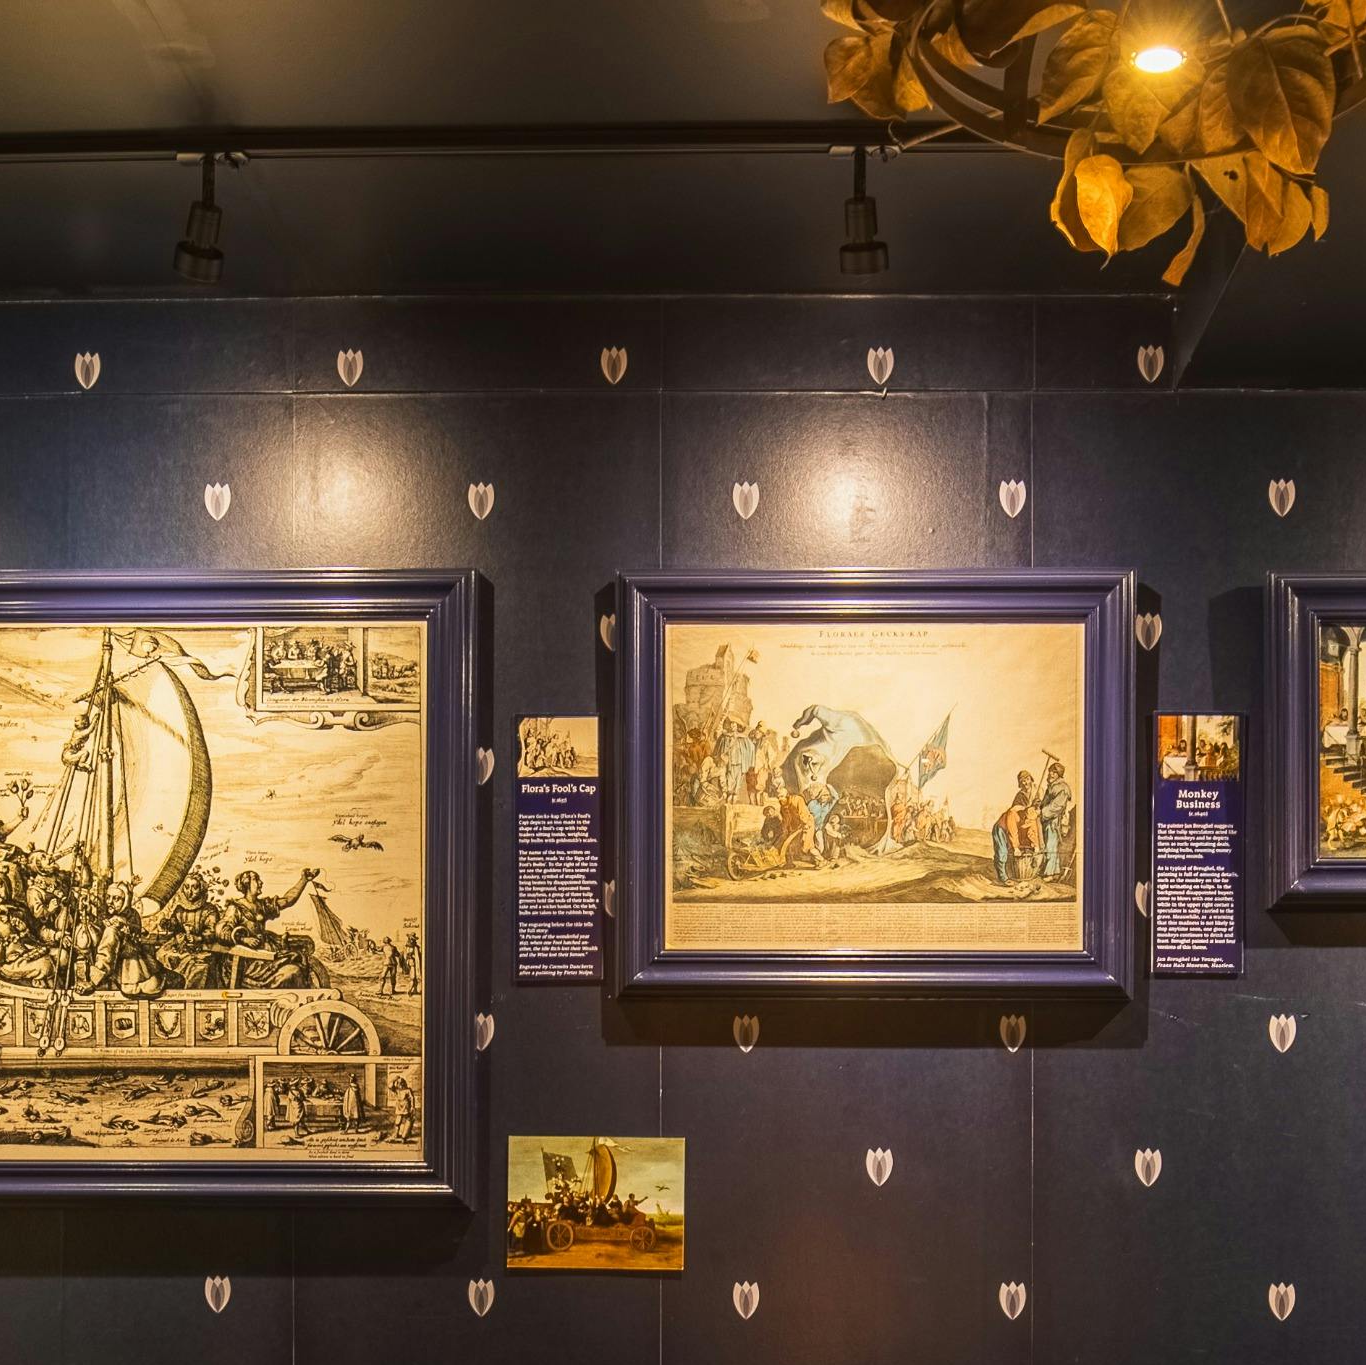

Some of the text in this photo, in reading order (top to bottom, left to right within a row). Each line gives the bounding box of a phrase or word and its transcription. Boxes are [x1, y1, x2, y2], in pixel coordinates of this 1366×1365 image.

[522, 784, 596, 794] Flora's Fool's Cap
[1179, 790, 1219, 800] Monkey
[1176, 800, 1221, 808] Business
